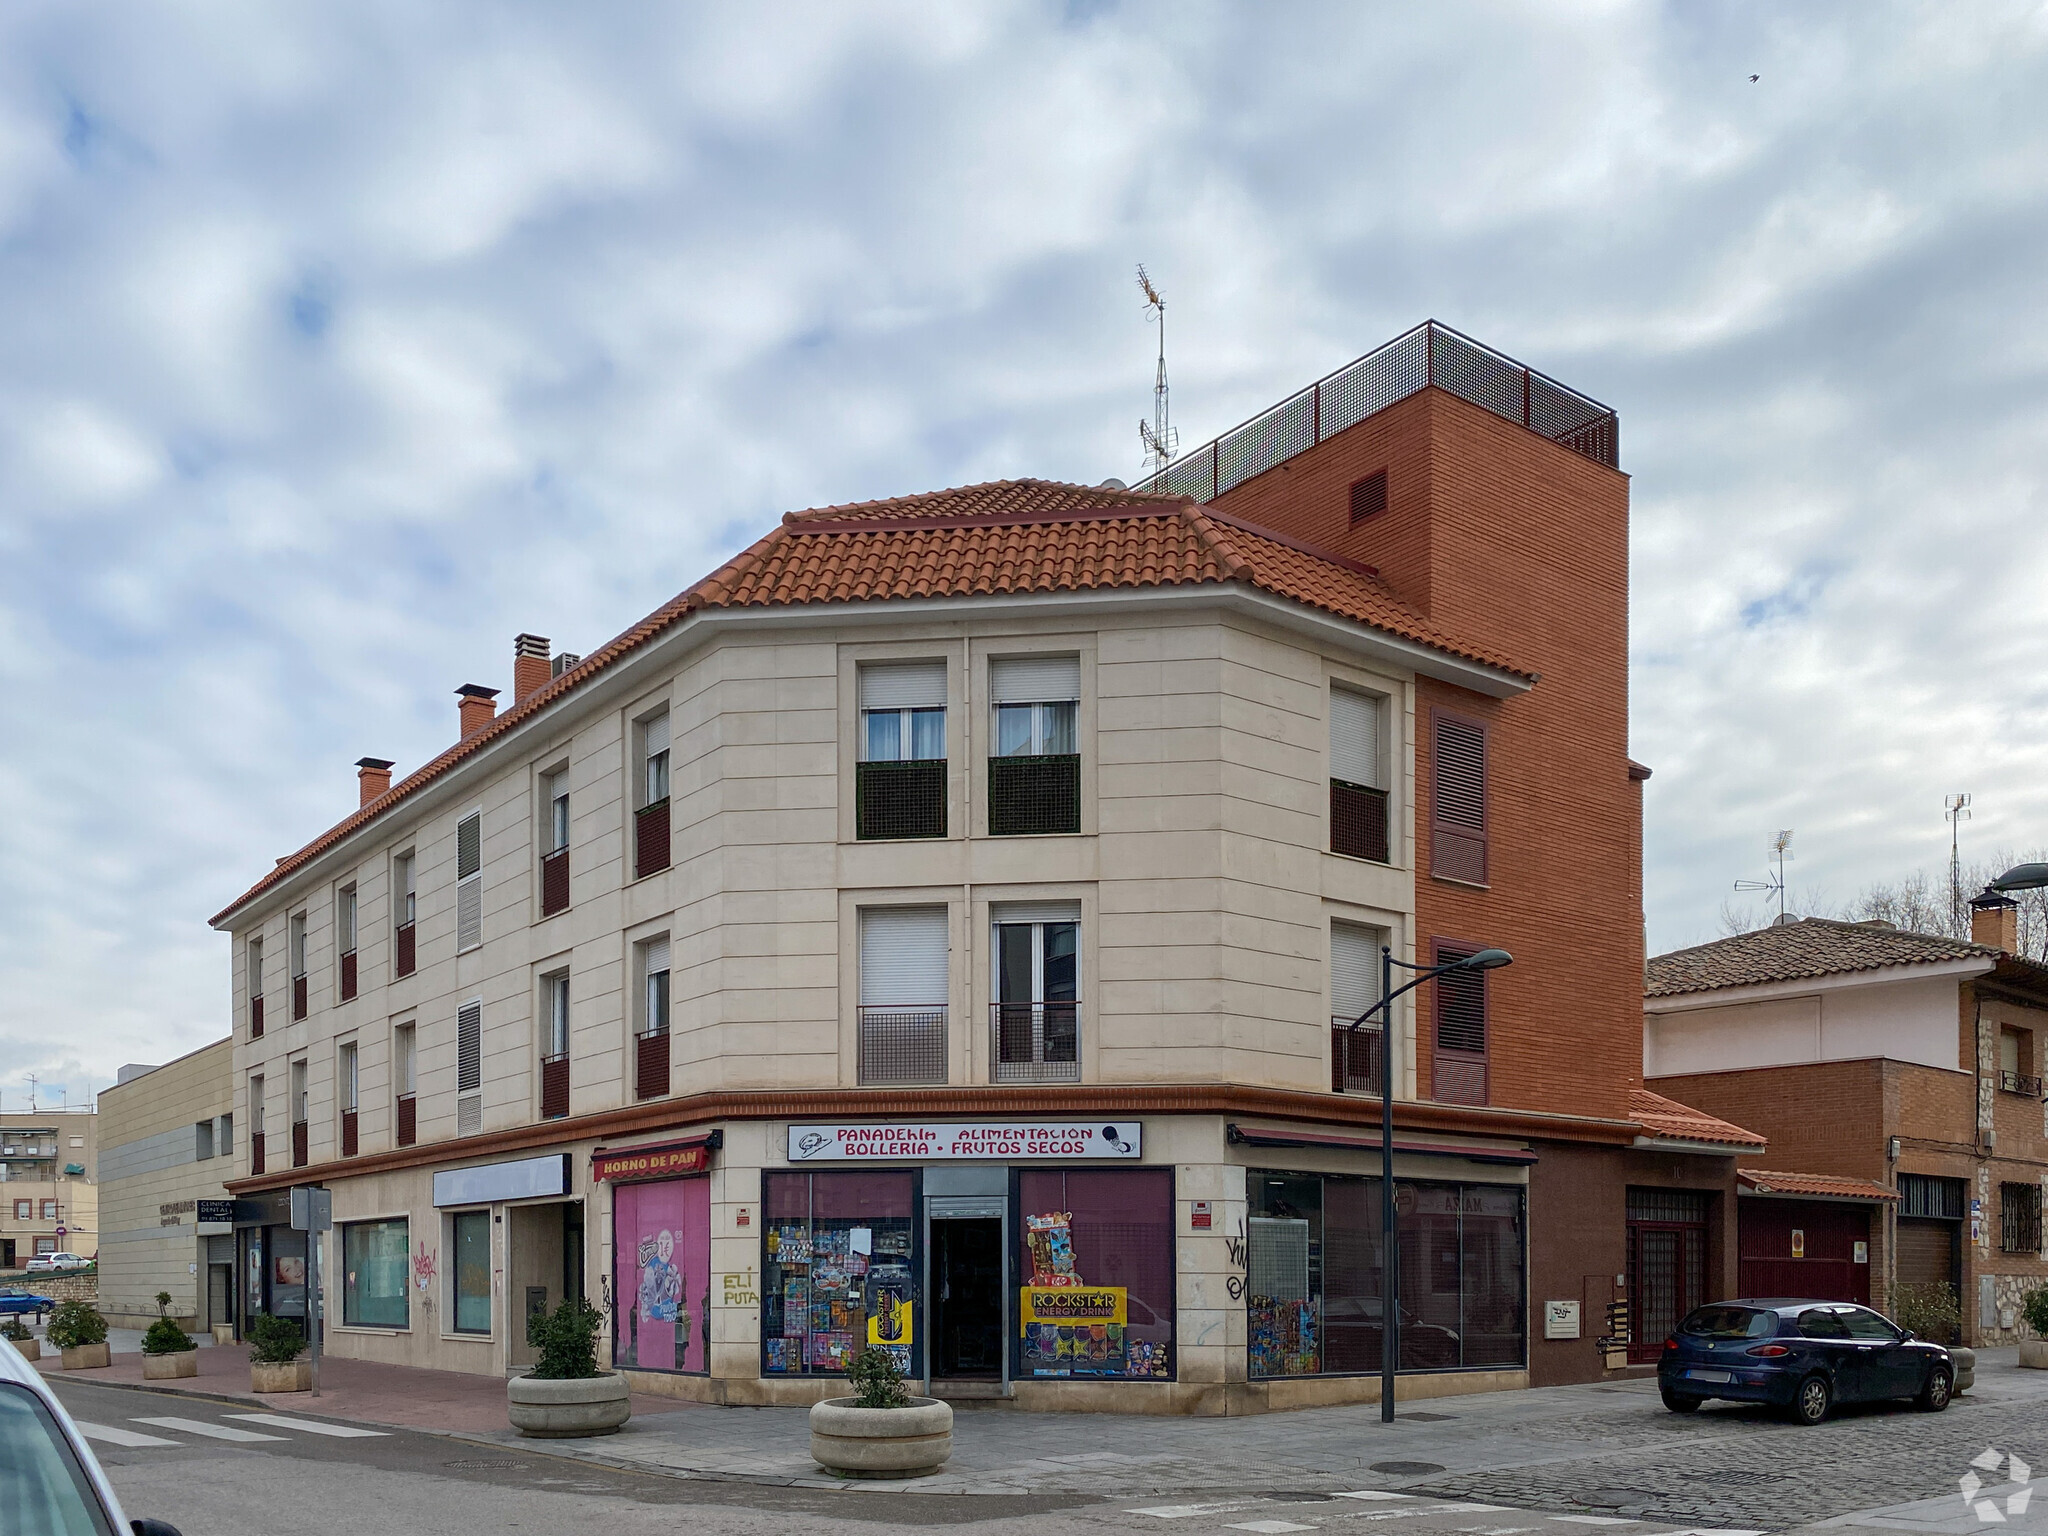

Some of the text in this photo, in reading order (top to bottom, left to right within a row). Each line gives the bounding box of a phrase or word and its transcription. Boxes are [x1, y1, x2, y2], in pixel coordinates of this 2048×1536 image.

[845, 1141, 1085, 1156] BOLLERIA FRUTOS SECOS
[604, 1151, 697, 1174] HORNO DE PAN
[724, 1291, 760, 1306] PUTA
[1033, 1293, 1115, 1307] ROCKSTAR
[1036, 1307, 1112, 1316] ENERGY DRINK
